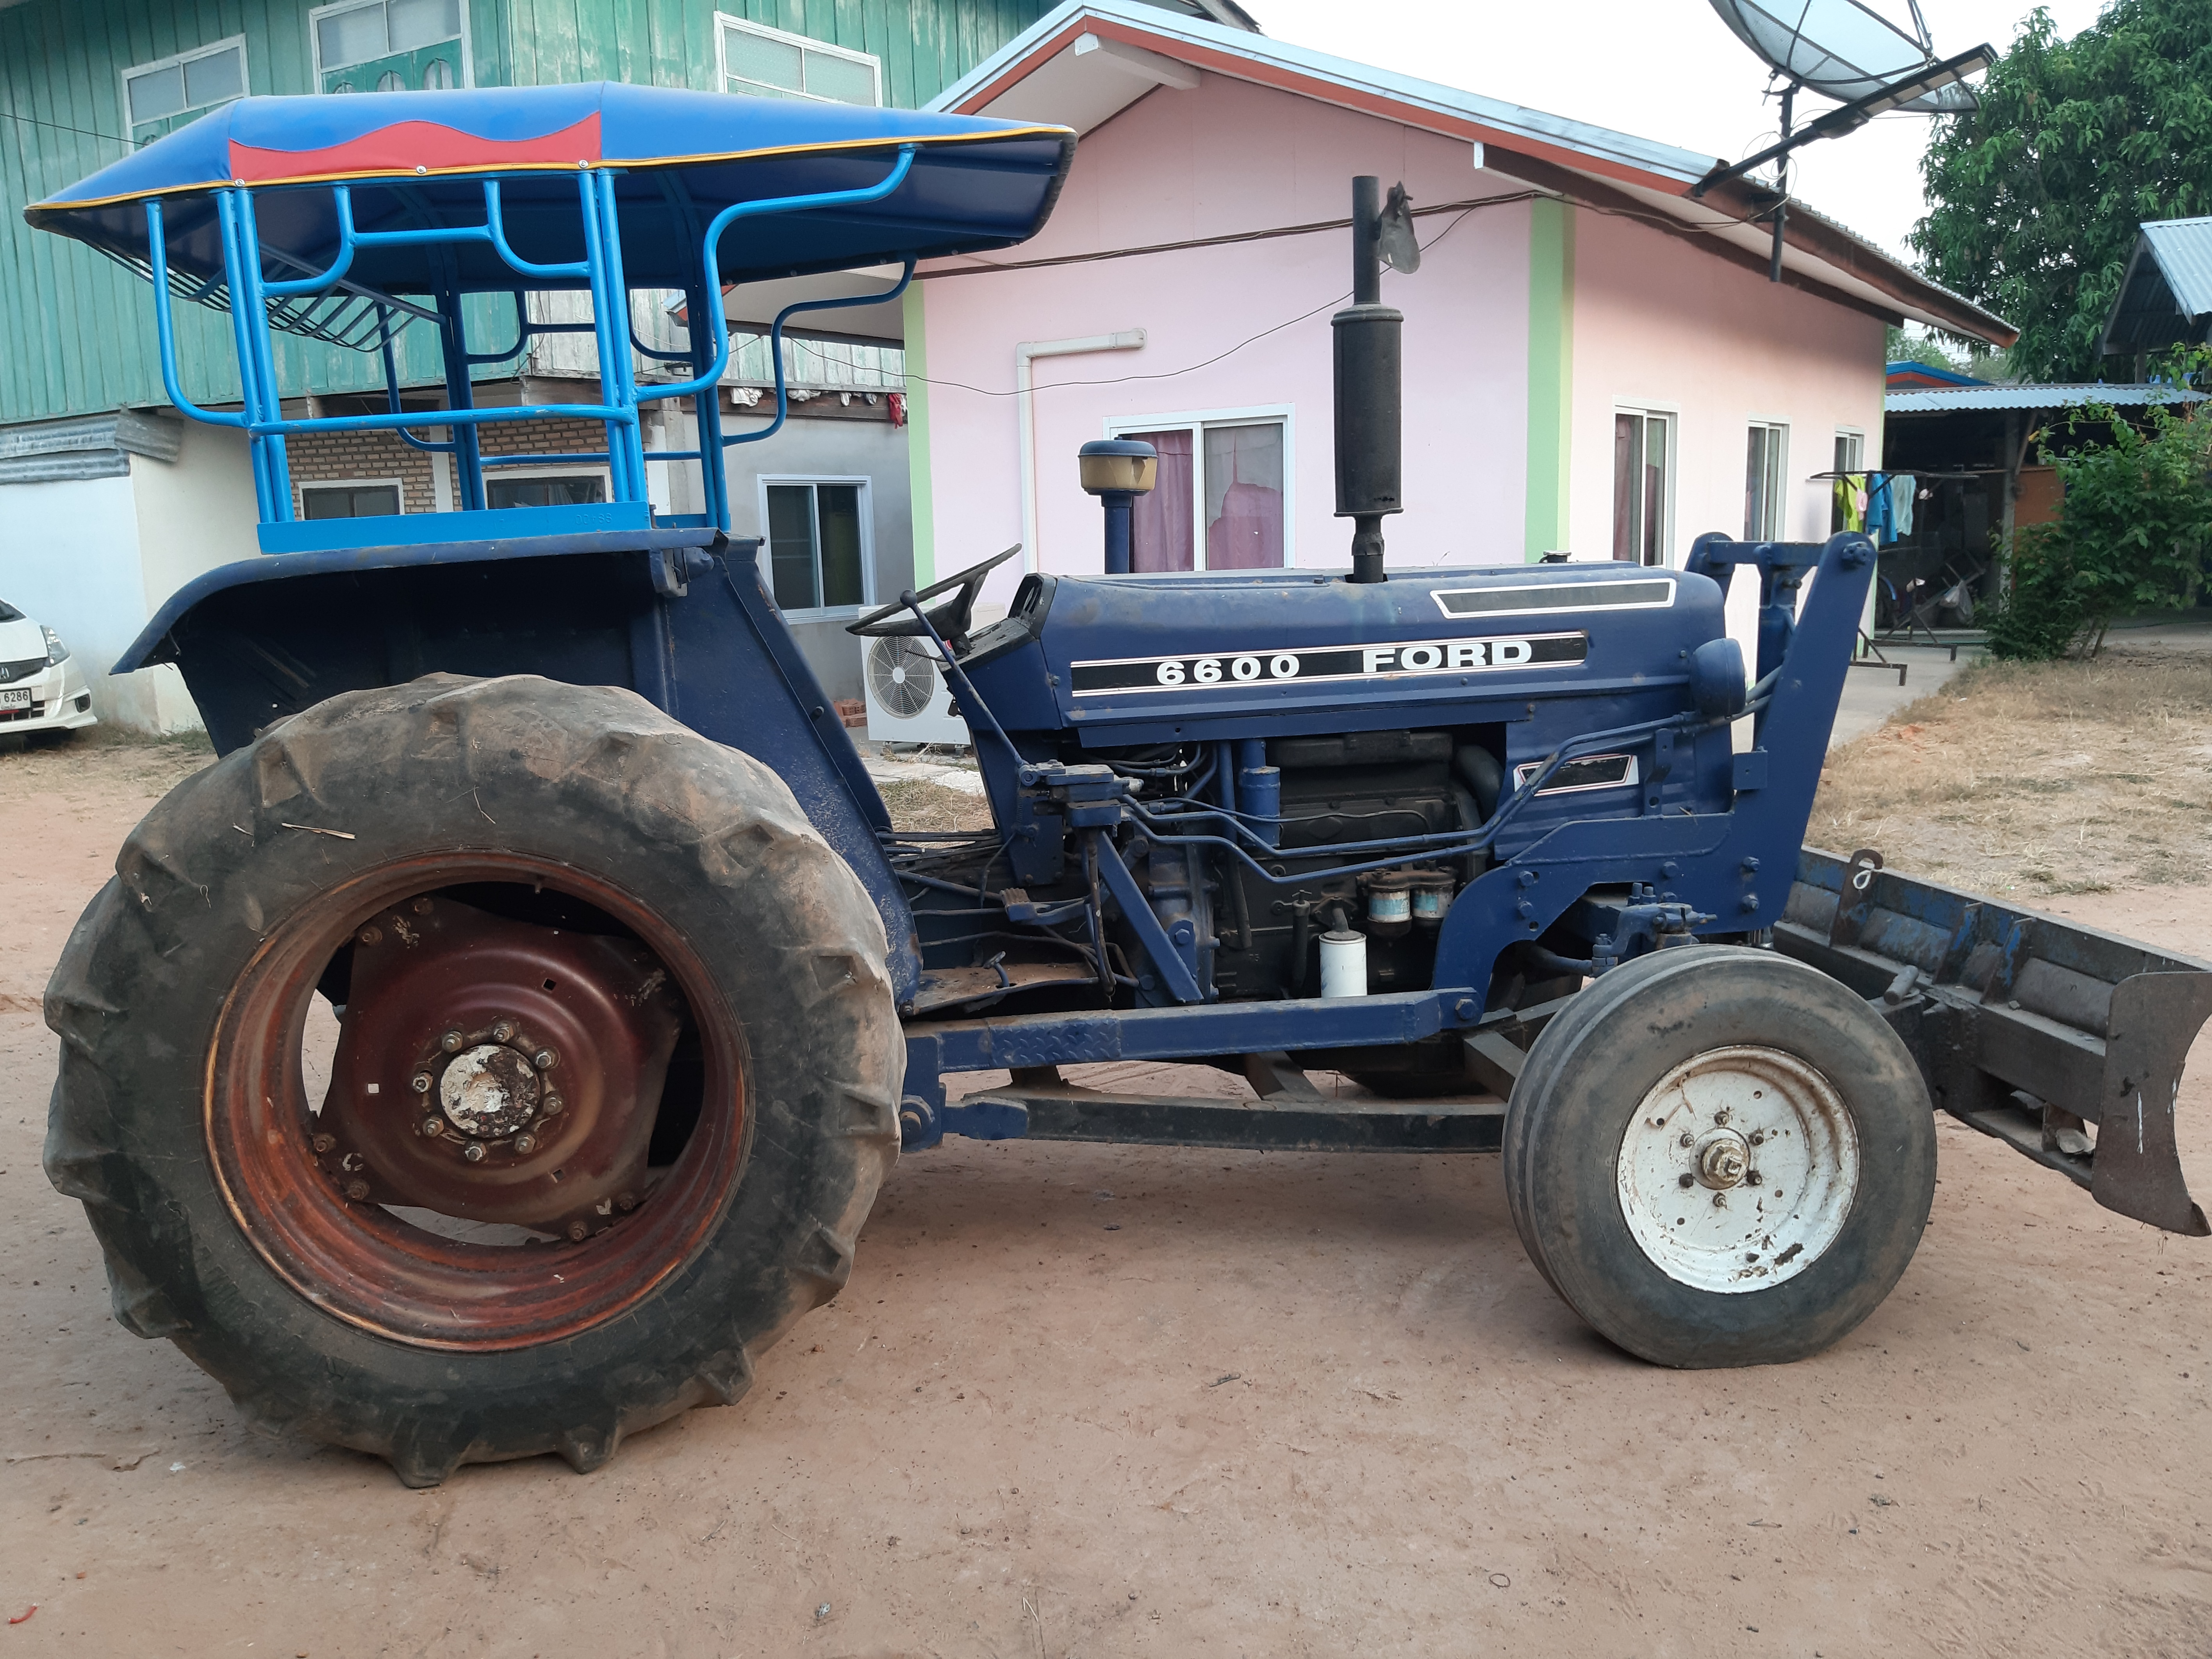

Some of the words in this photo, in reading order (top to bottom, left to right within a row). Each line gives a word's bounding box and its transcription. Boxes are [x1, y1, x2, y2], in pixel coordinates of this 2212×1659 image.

[1156, 654, 1300, 685] 6600
[1363, 640, 1532, 673] FORD
[4, 691, 28, 703] 6286
